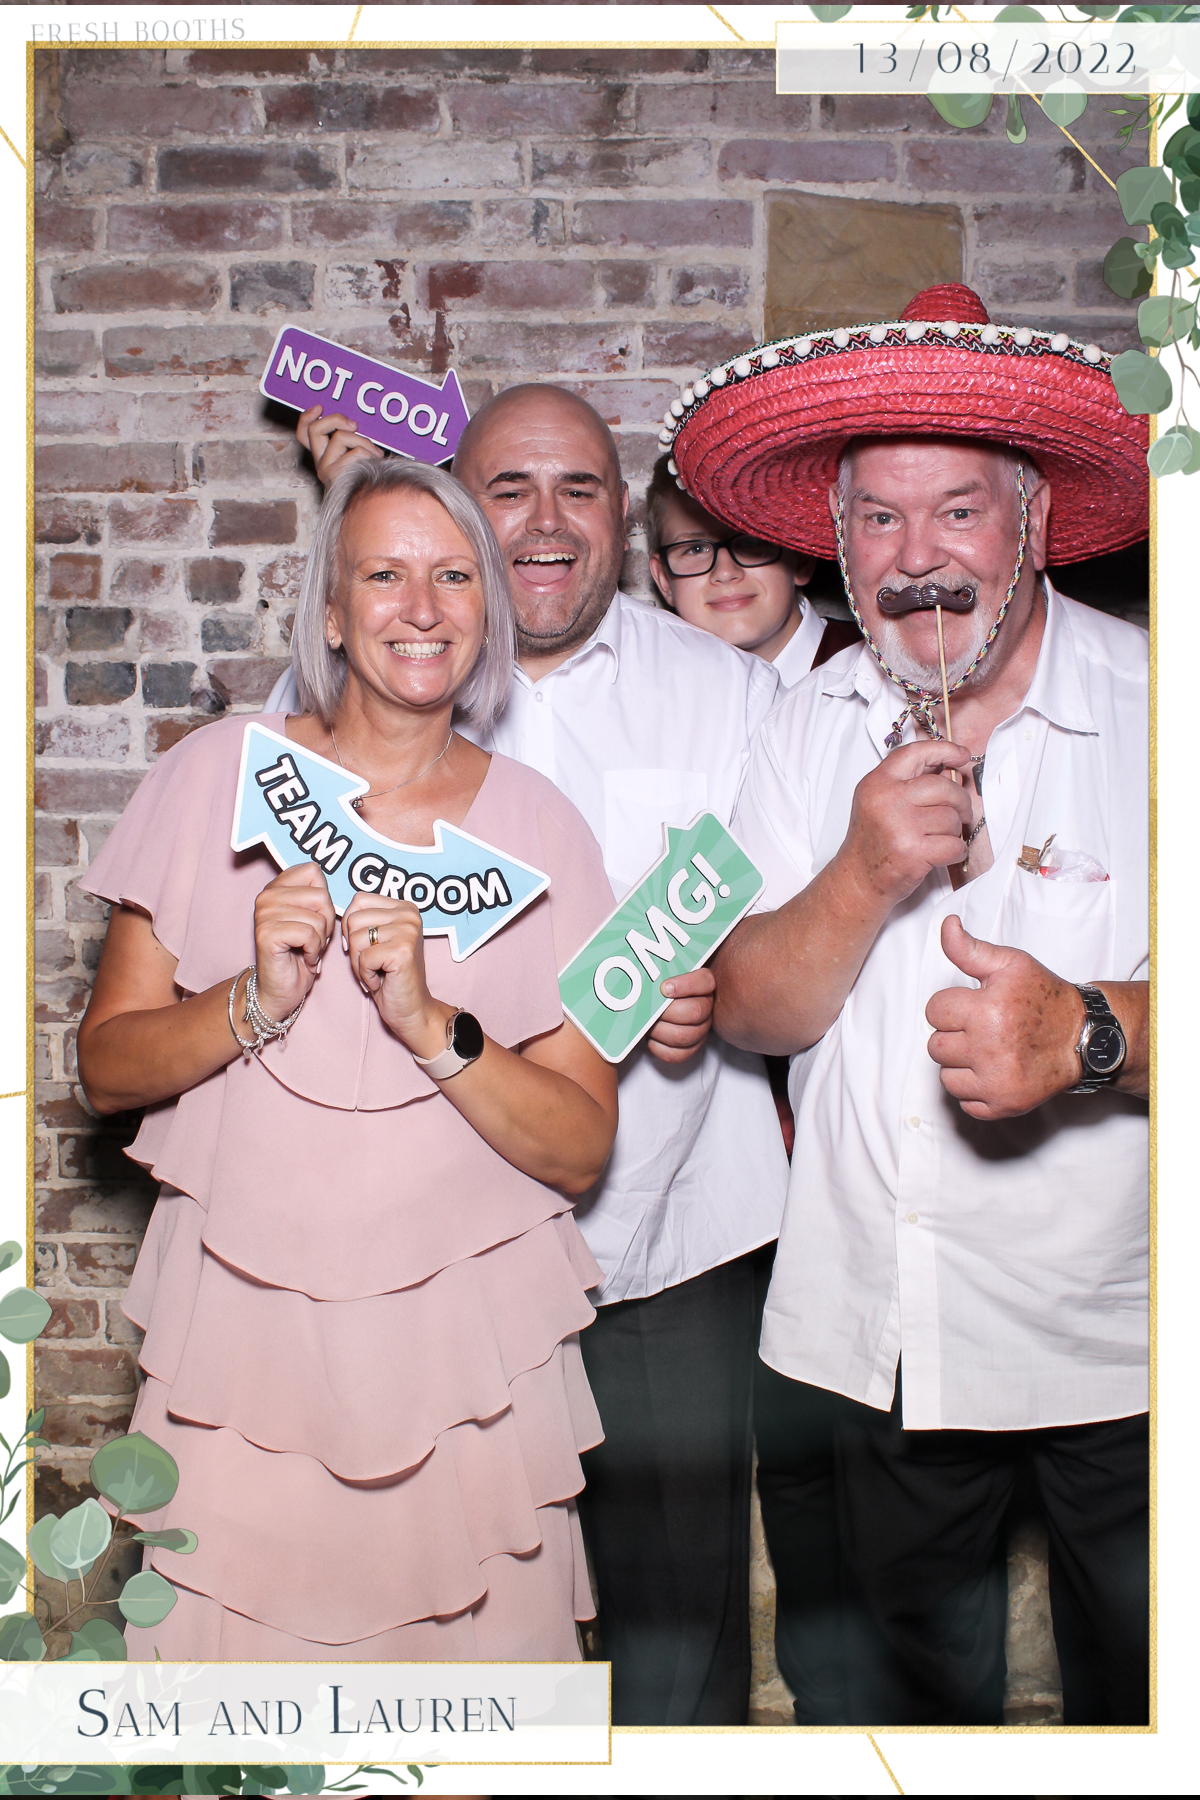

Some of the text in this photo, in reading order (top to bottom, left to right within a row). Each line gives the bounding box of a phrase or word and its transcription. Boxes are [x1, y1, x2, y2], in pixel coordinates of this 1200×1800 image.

[276, 345, 450, 446] NOT COOL
[255, 753, 513, 915] TEAM GROOM
[593, 852, 731, 1012] OMG!
